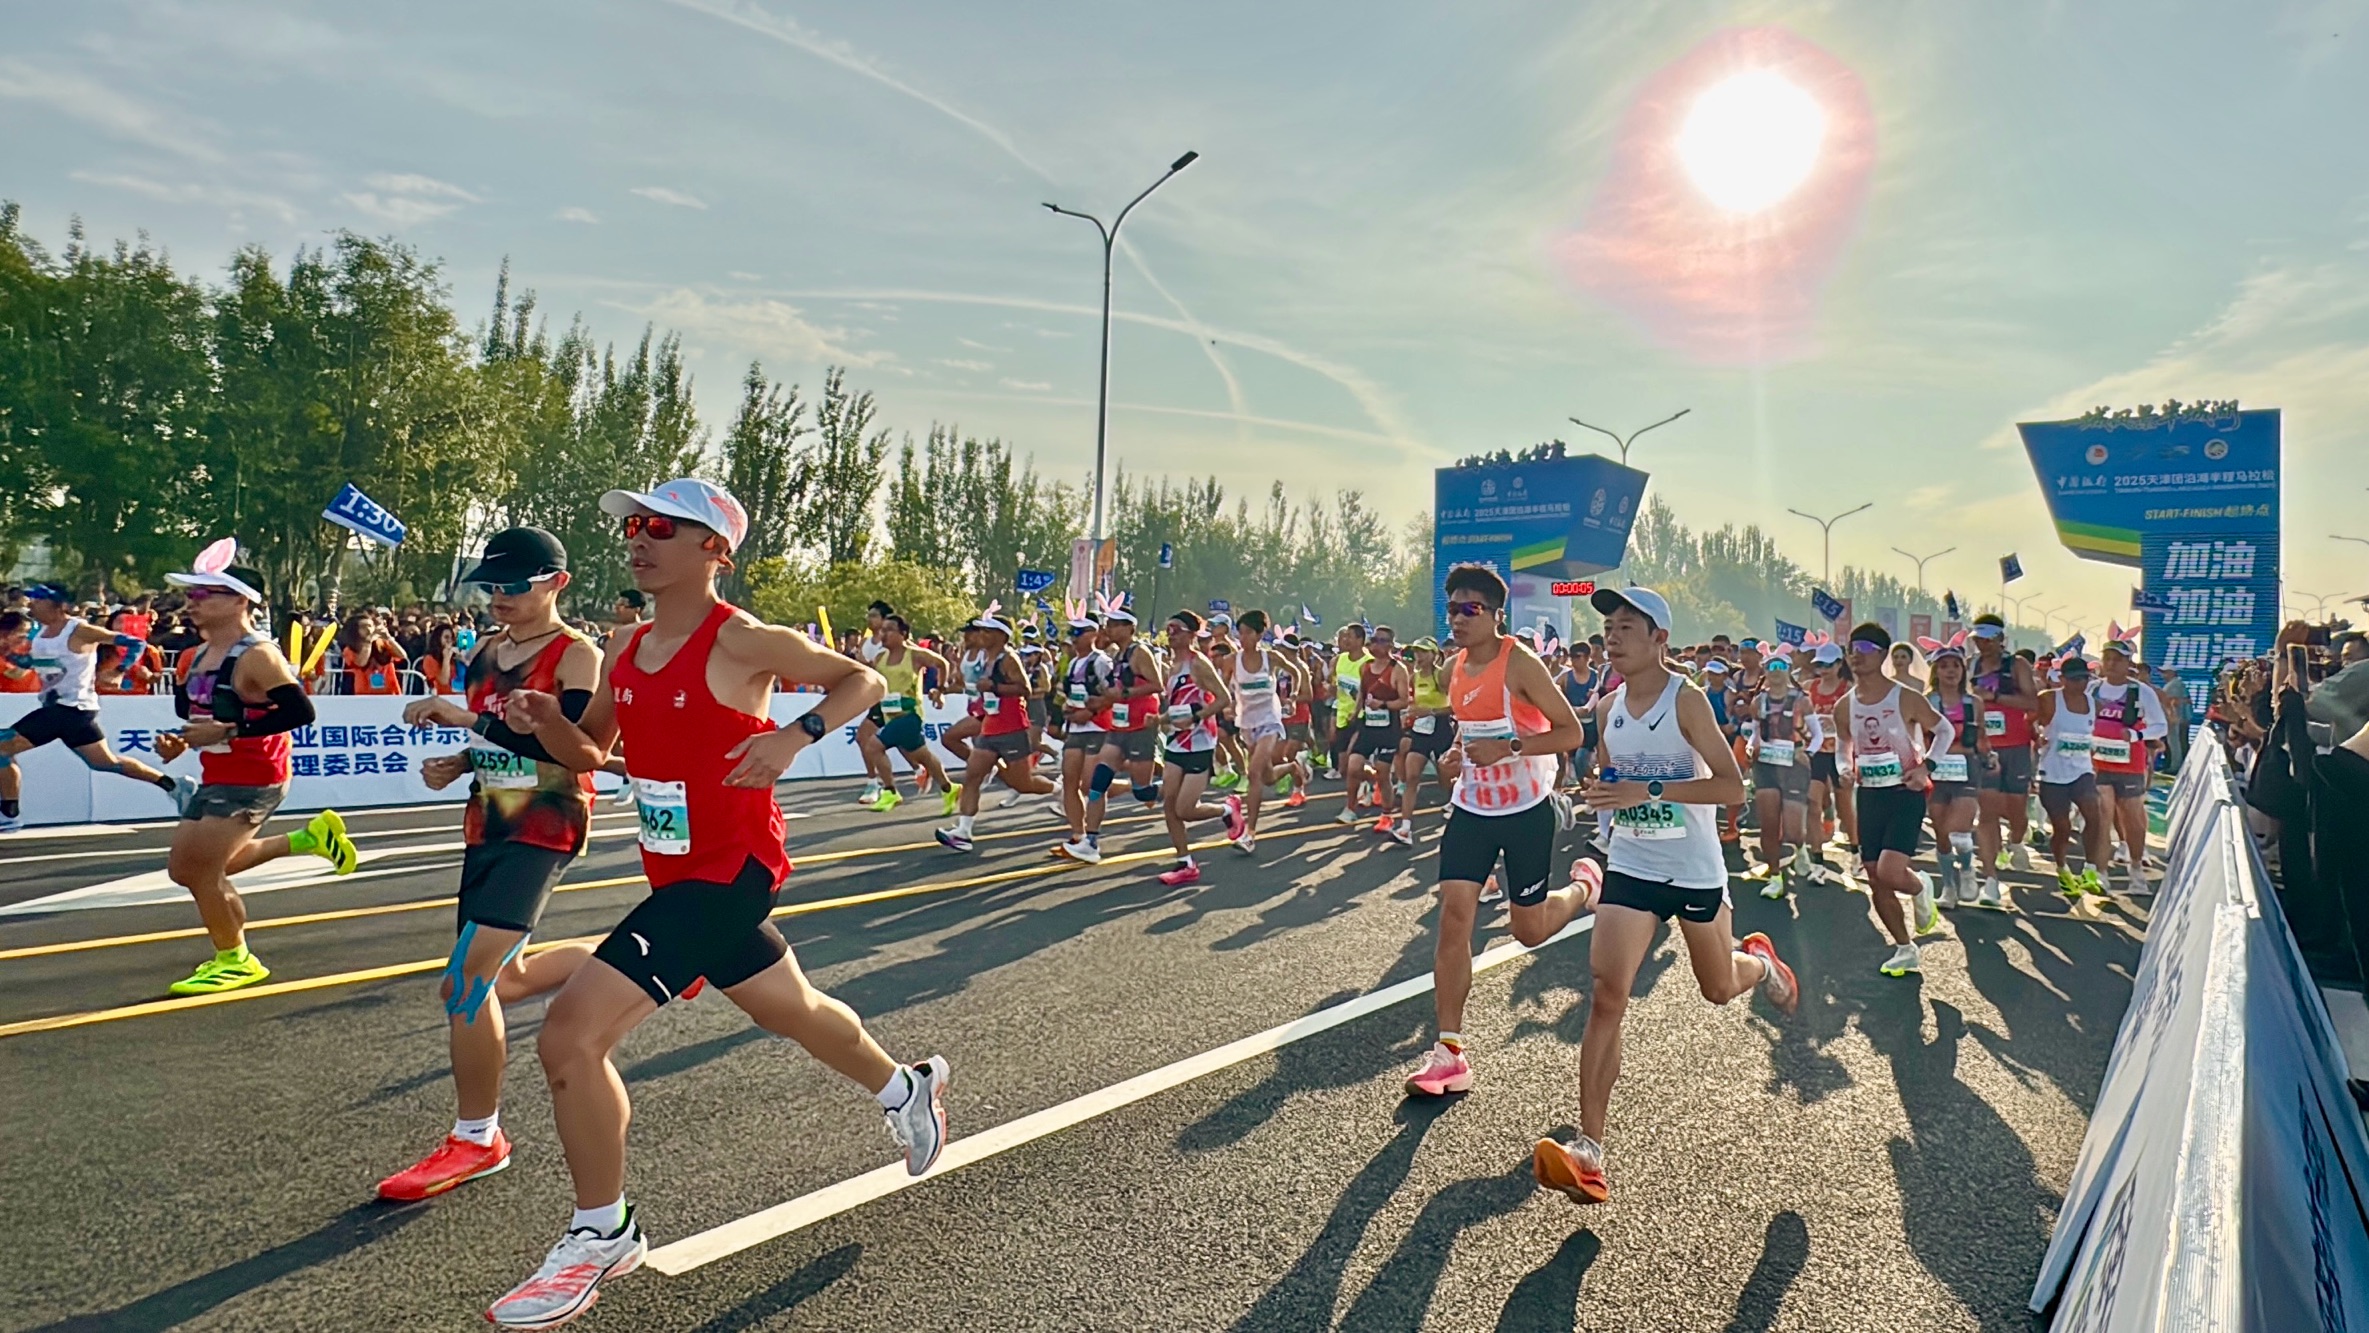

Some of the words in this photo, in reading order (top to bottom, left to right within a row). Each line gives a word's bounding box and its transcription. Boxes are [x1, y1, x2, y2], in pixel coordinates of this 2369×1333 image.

[339, 491, 398, 533] 1:30
[2163, 540, 2257, 580] 加油
[1552, 583, 1593, 594] 00:00:05
[2162, 586, 2257, 626] 加油
